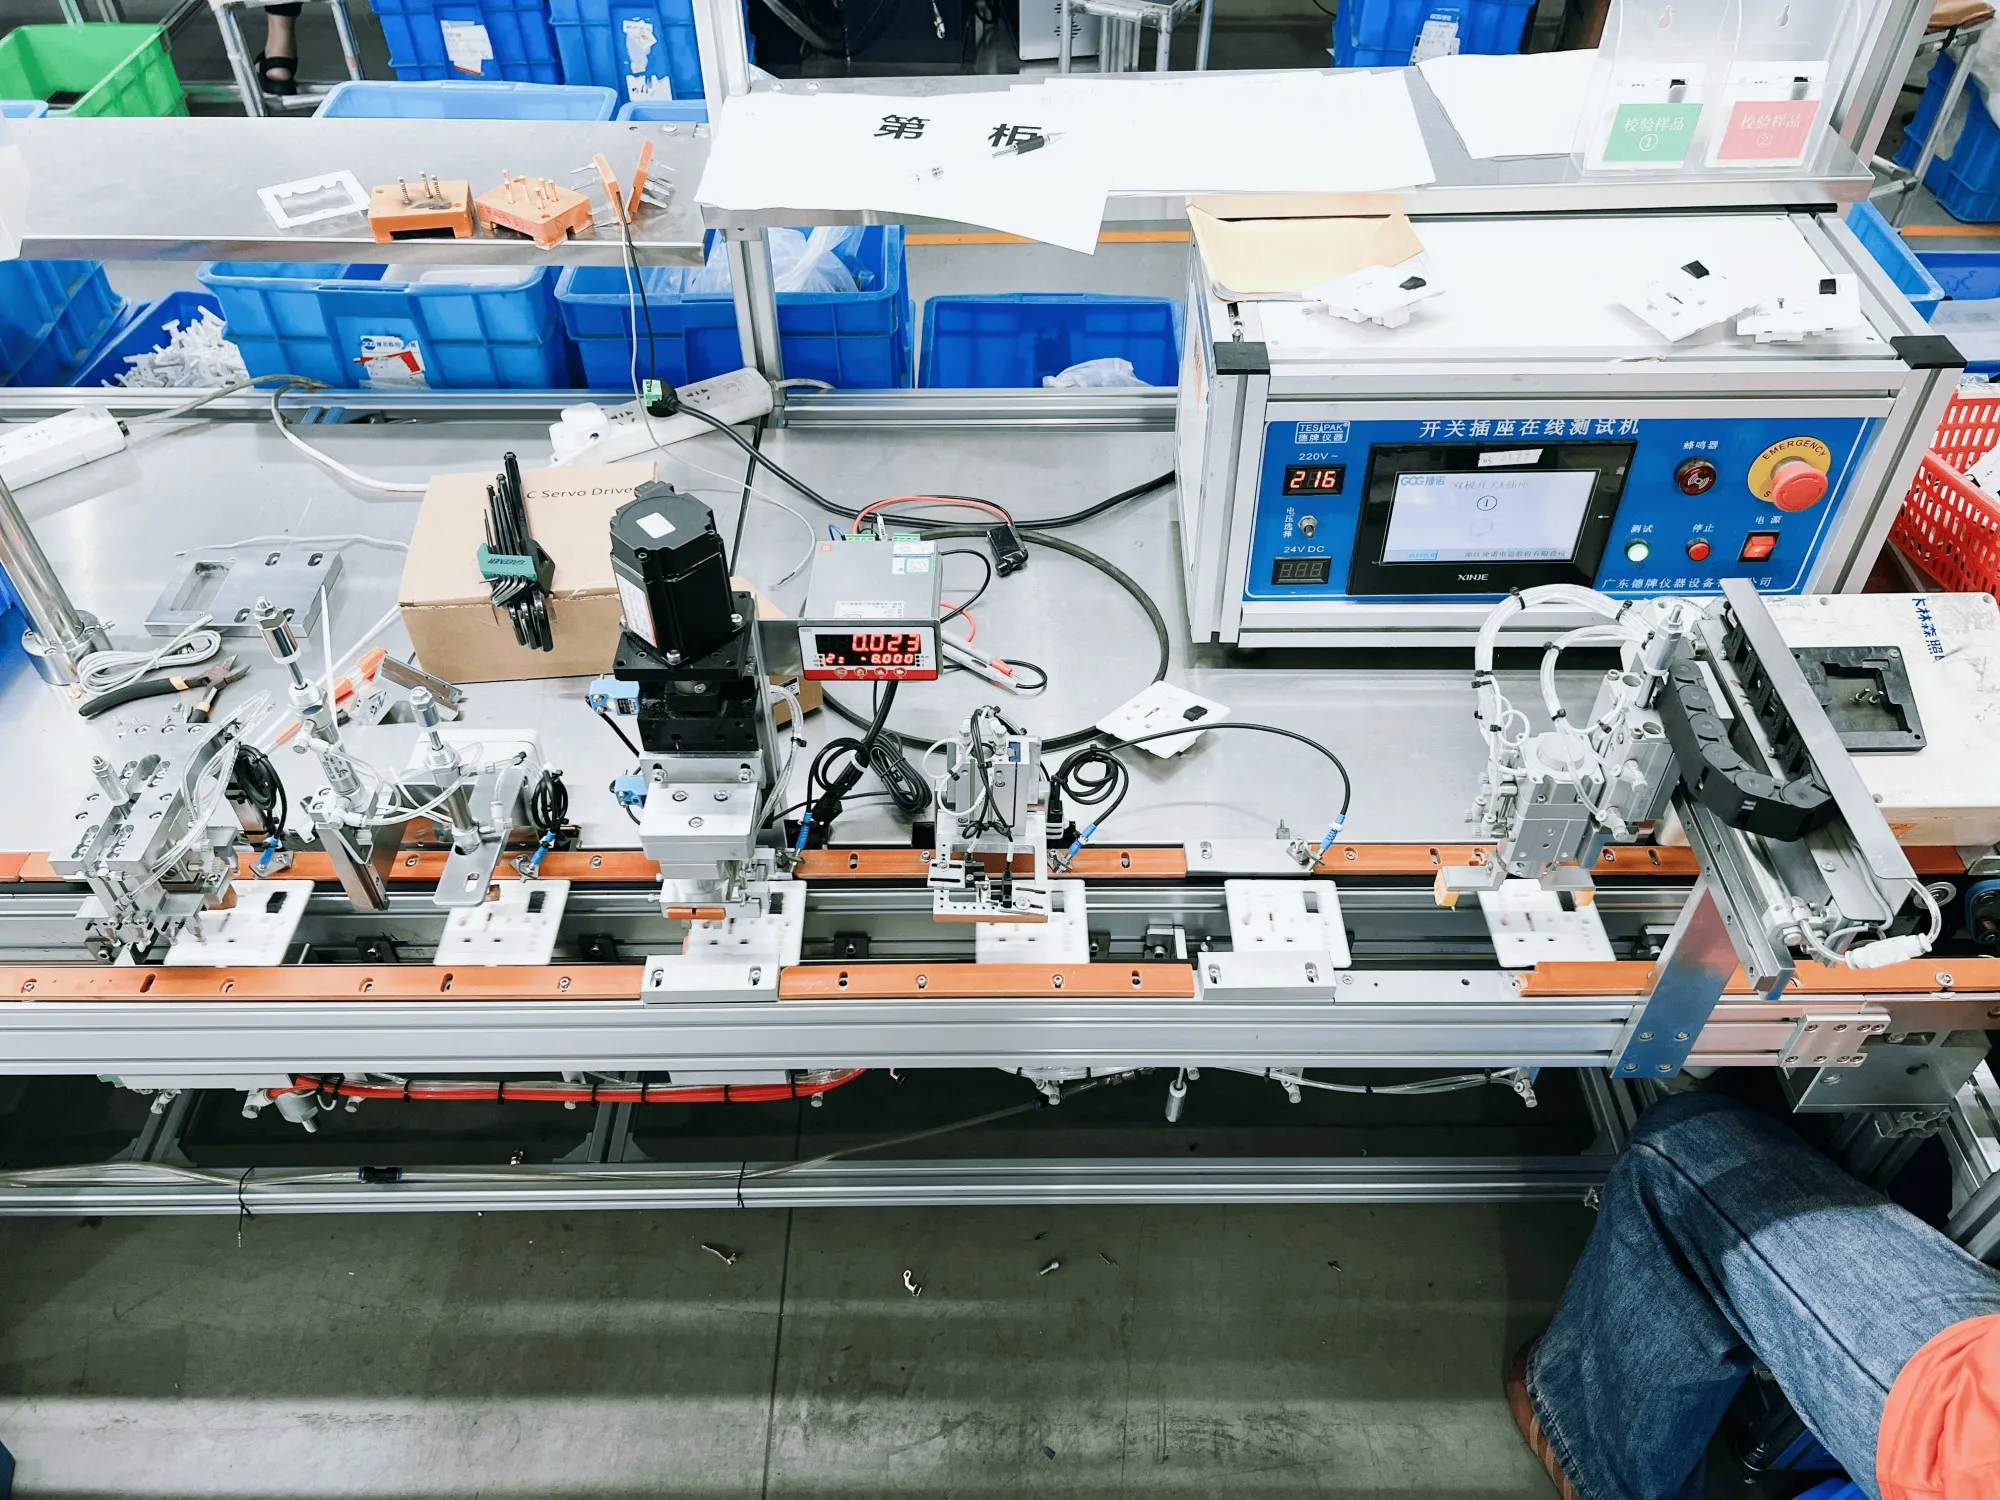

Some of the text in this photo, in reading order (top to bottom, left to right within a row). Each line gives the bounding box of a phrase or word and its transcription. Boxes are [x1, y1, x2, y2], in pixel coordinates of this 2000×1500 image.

[873, 114, 931, 139] 第
[1624, 116, 1684, 132] 校验样品
[1740, 113, 1800, 129] 校验样品
[1419, 419, 1640, 438] 开关插座在线测试机
[1683, 440, 1719, 450] 蜂鸣器
[1762, 440, 1827, 460] EMERGENCY
[1299, 452, 1329, 461] 220V
[1290, 470, 1336, 488] 216
[541, 489, 587, 499] Servo
[1283, 506, 1295, 538] 电压选择
[1630, 524, 1654, 534] 测试
[1692, 523, 1715, 533] 停止
[1307, 545, 1325, 553] DC
[1457, 573, 1489, 581] XINJE
[1601, 577, 1773, 589] 广东德牌仪器设备司
[852, 633, 920, 652] 0.023
